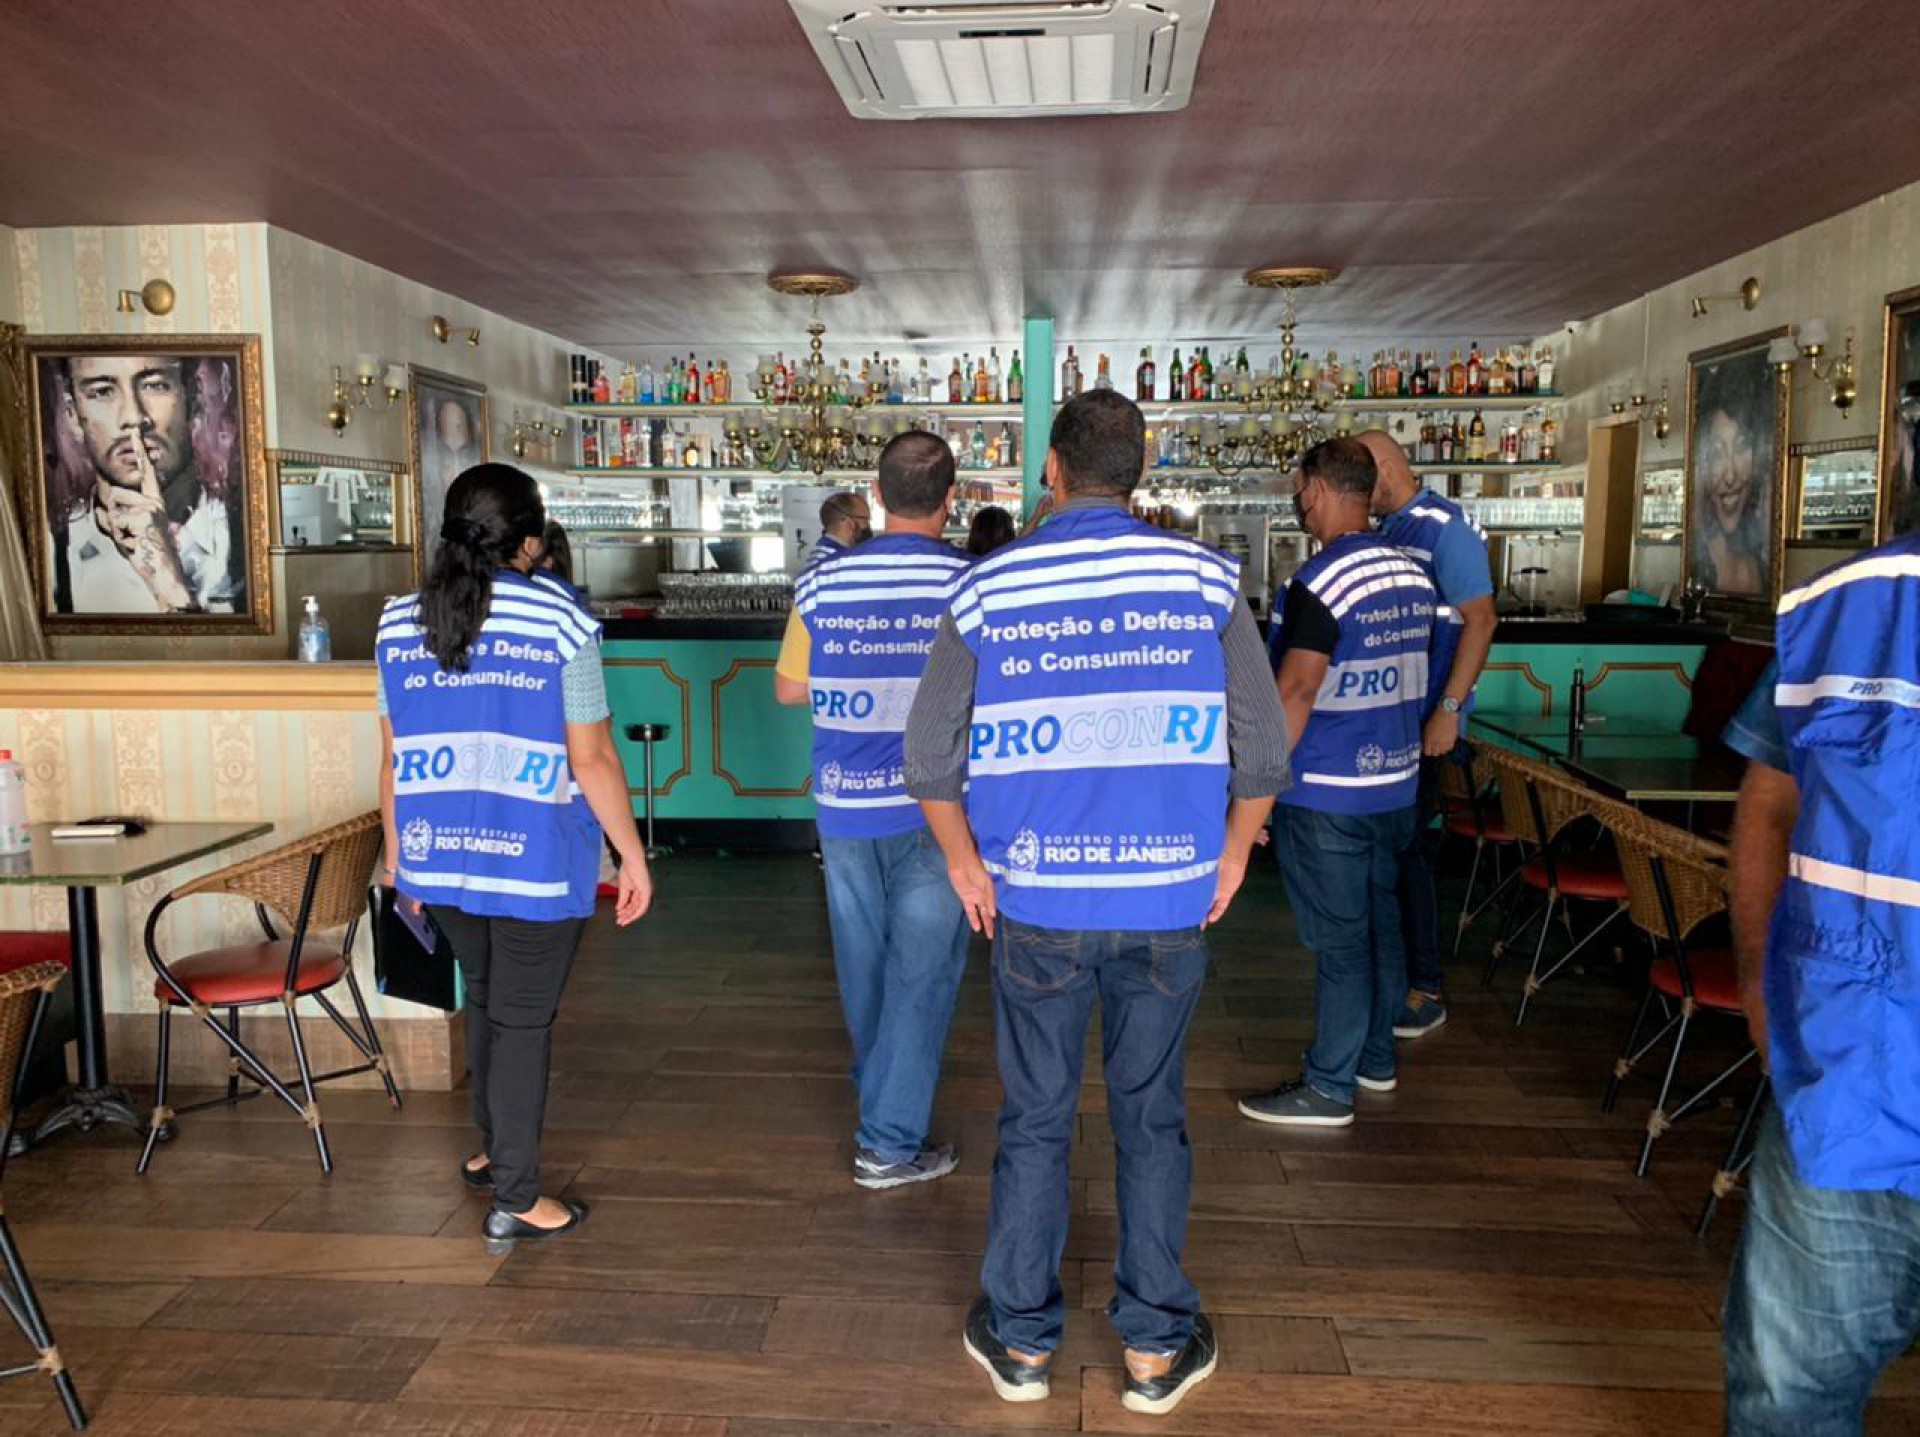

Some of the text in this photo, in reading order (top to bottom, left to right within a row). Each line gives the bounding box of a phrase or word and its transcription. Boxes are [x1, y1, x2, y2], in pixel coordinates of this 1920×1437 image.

[814, 614, 941, 632] roteção e Def
[1100, 619, 1115, 634] e
[1124, 611, 1214, 631] Defesa
[478, 643, 488, 656] e
[823, 639, 933, 655] do Consumid
[1364, 633, 1381, 648] do
[1001, 645, 1194, 676] do Consumidor
[432, 670, 547, 691] Conumidor
[969, 704, 1223, 760] PROCONRJ
[1044, 833, 1195, 845] GOVERNO DO ESTADO
[1044, 844, 1195, 863] RIO DE JANEIRO
